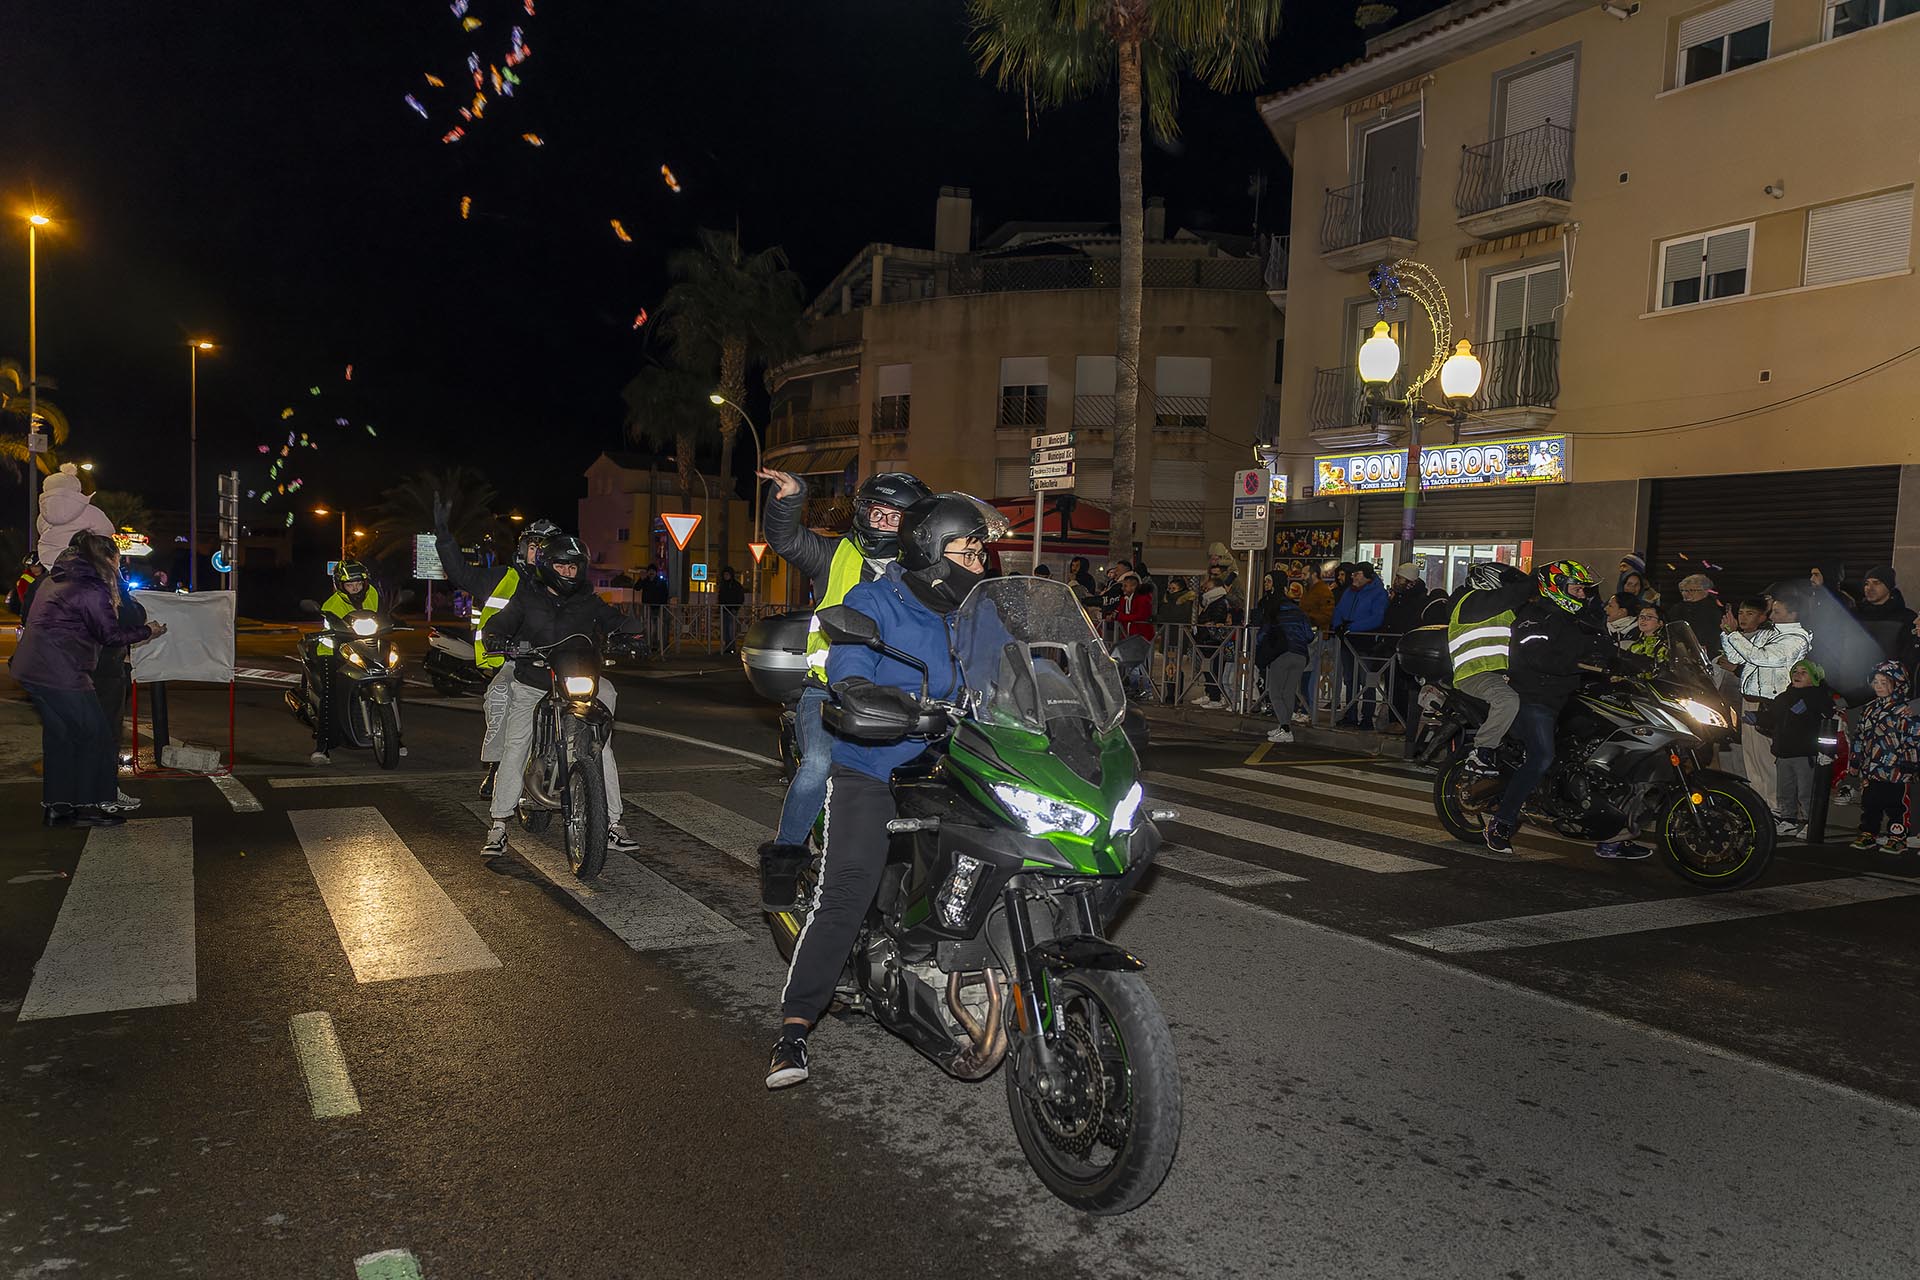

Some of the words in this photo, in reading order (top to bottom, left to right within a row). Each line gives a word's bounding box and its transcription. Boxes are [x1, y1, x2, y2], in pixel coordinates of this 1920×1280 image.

[1048, 434, 1067, 446] Municipal
[1048, 450, 1065, 461] Municipal
[1350, 455, 1400, 482] BON
